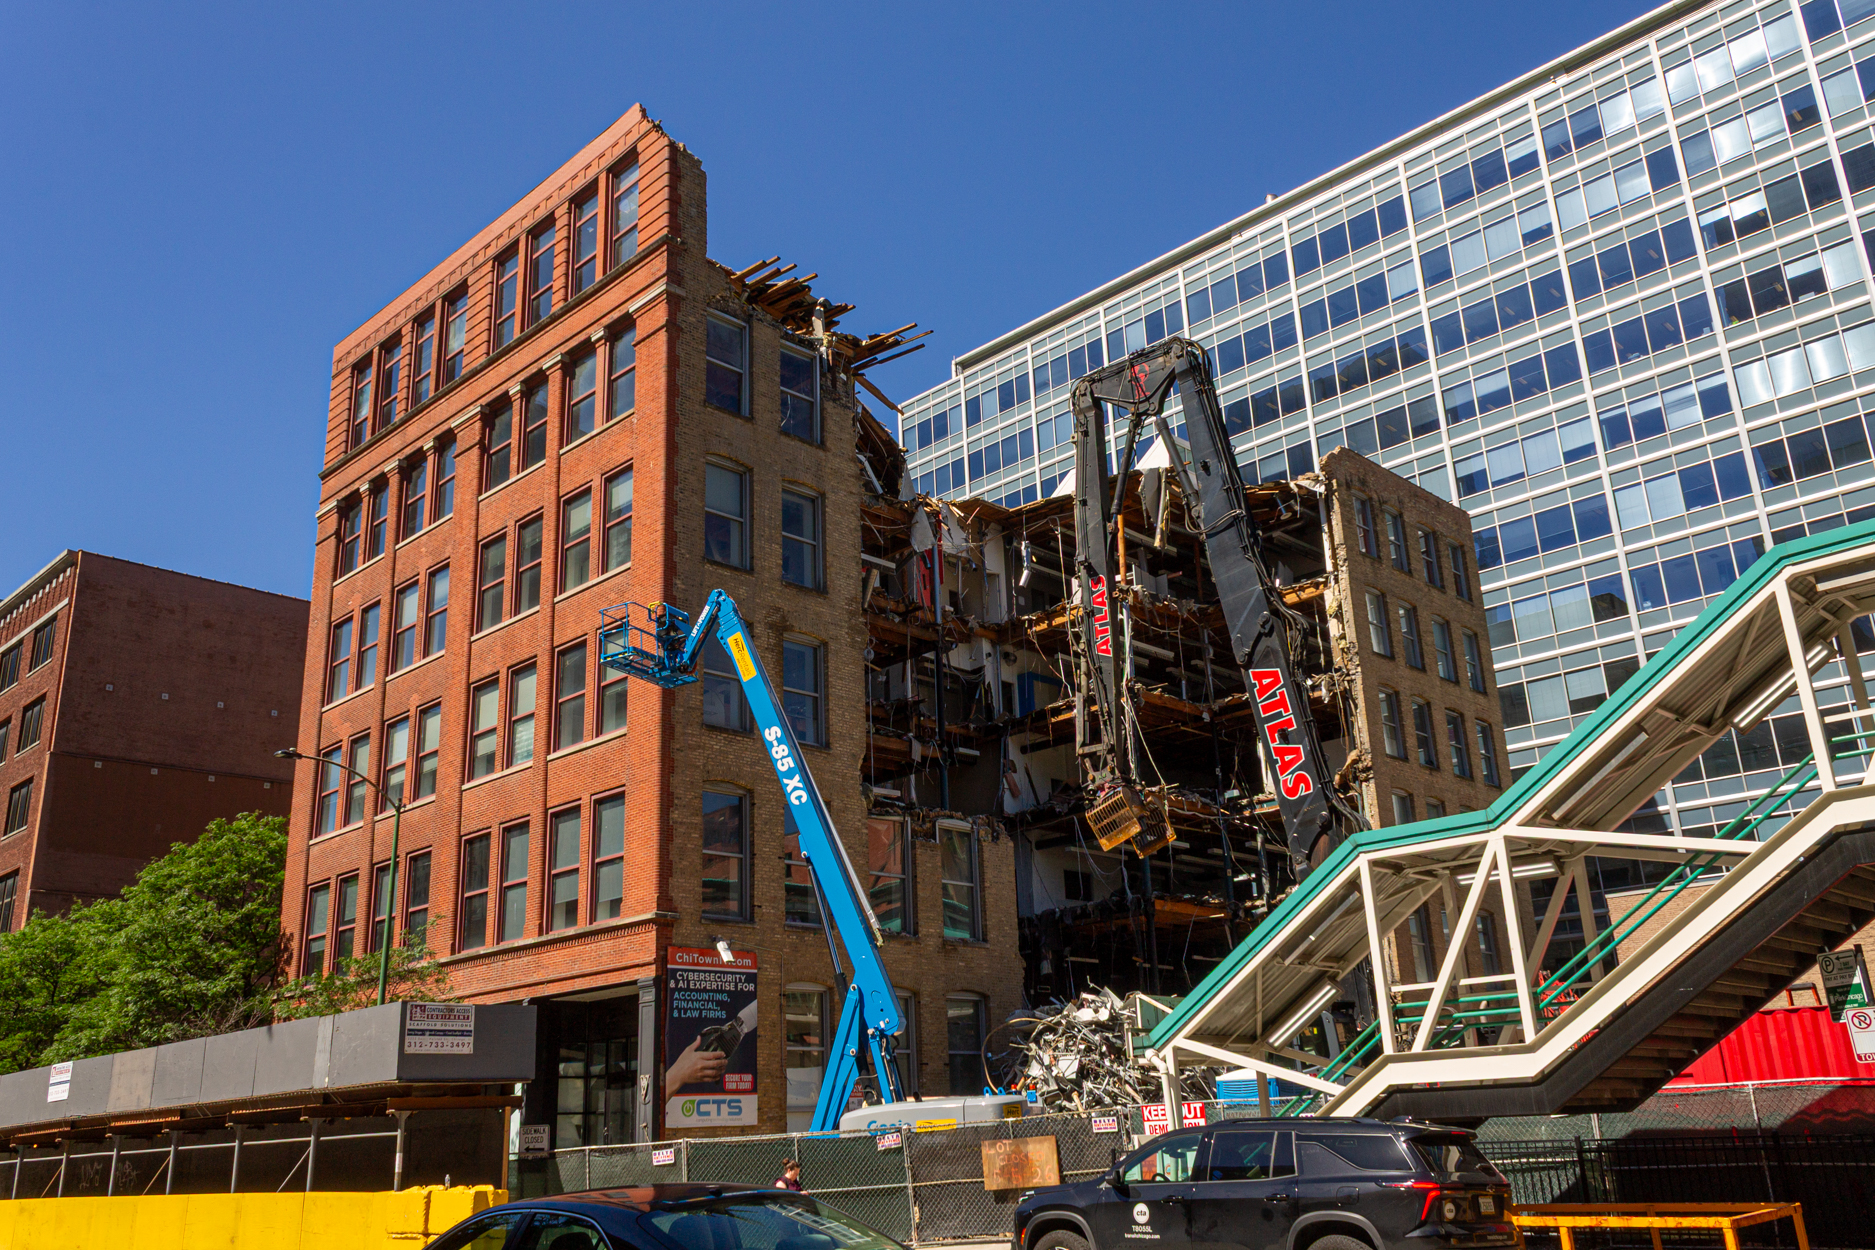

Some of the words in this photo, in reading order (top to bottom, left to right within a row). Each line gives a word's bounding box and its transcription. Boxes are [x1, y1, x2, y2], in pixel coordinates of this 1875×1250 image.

[1090, 575, 1113, 657] ATLAS
[1249, 668, 1313, 800] ATLAS
[764, 725, 795, 773] S-85
[782, 773, 808, 806] XC
[676, 971, 747, 983] CYBERSECURITY
[669, 979, 676, 988] &
[677, 980, 687, 989] AI
[689, 980, 736, 991] EXPERTISE
[737, 983, 755, 992] FOR
[673, 991, 731, 1002] ACCOUNTING,
[673, 1000, 721, 1011] FINANCIAL,
[672, 1009, 679, 1018] &
[680, 1009, 699, 1018] LAW
[701, 1010, 727, 1019] FIRMS
[407, 1041, 471, 1049] 312-733-3497
[726, 1082, 737, 1090] FIRM
[696, 1099, 743, 1117] CTS
[1143, 1104, 1166, 1121] KEE
[521, 1127, 547, 1135] SIDEWALK
[524, 1136, 544, 1144] CLOSED
[985, 1140, 1012, 1154] LOT
